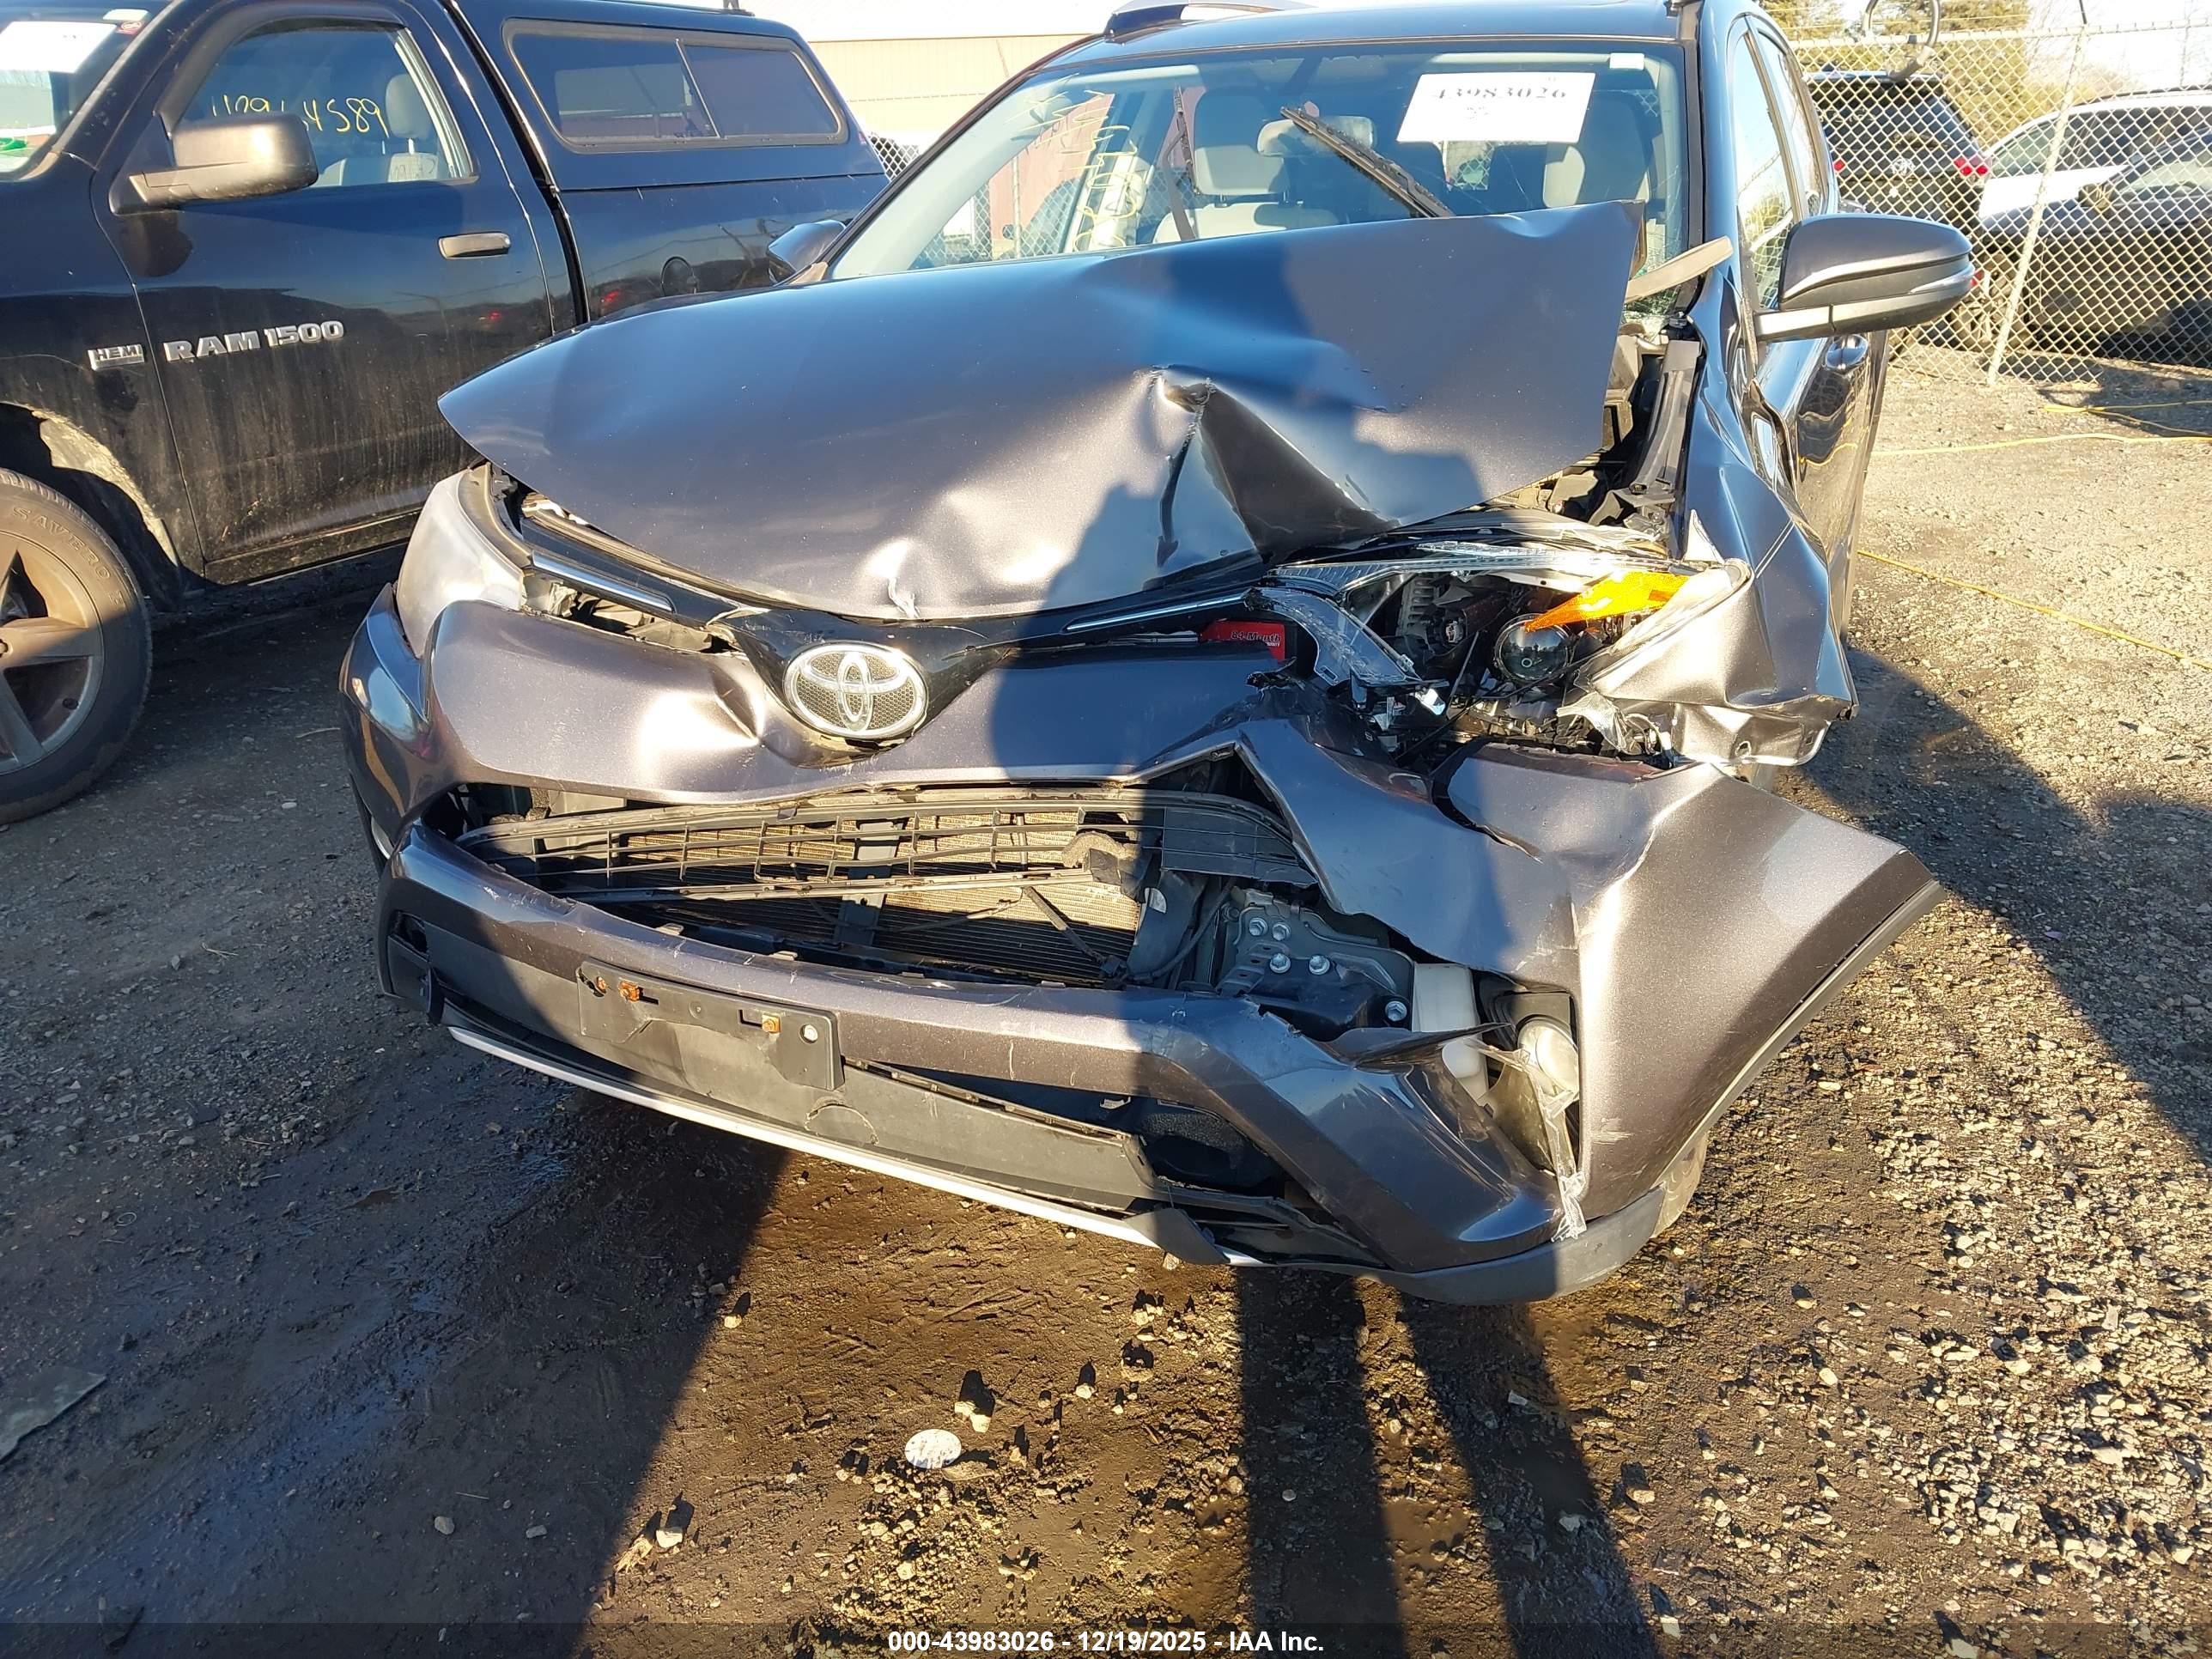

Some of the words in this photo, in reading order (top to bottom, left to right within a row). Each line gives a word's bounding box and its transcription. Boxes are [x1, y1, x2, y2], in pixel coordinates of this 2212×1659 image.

[93, 344, 142, 362] HEMI
[163, 330, 261, 362] RAM
[264, 320, 344, 347] 1500
[12, 507, 112, 580] SAVERO
